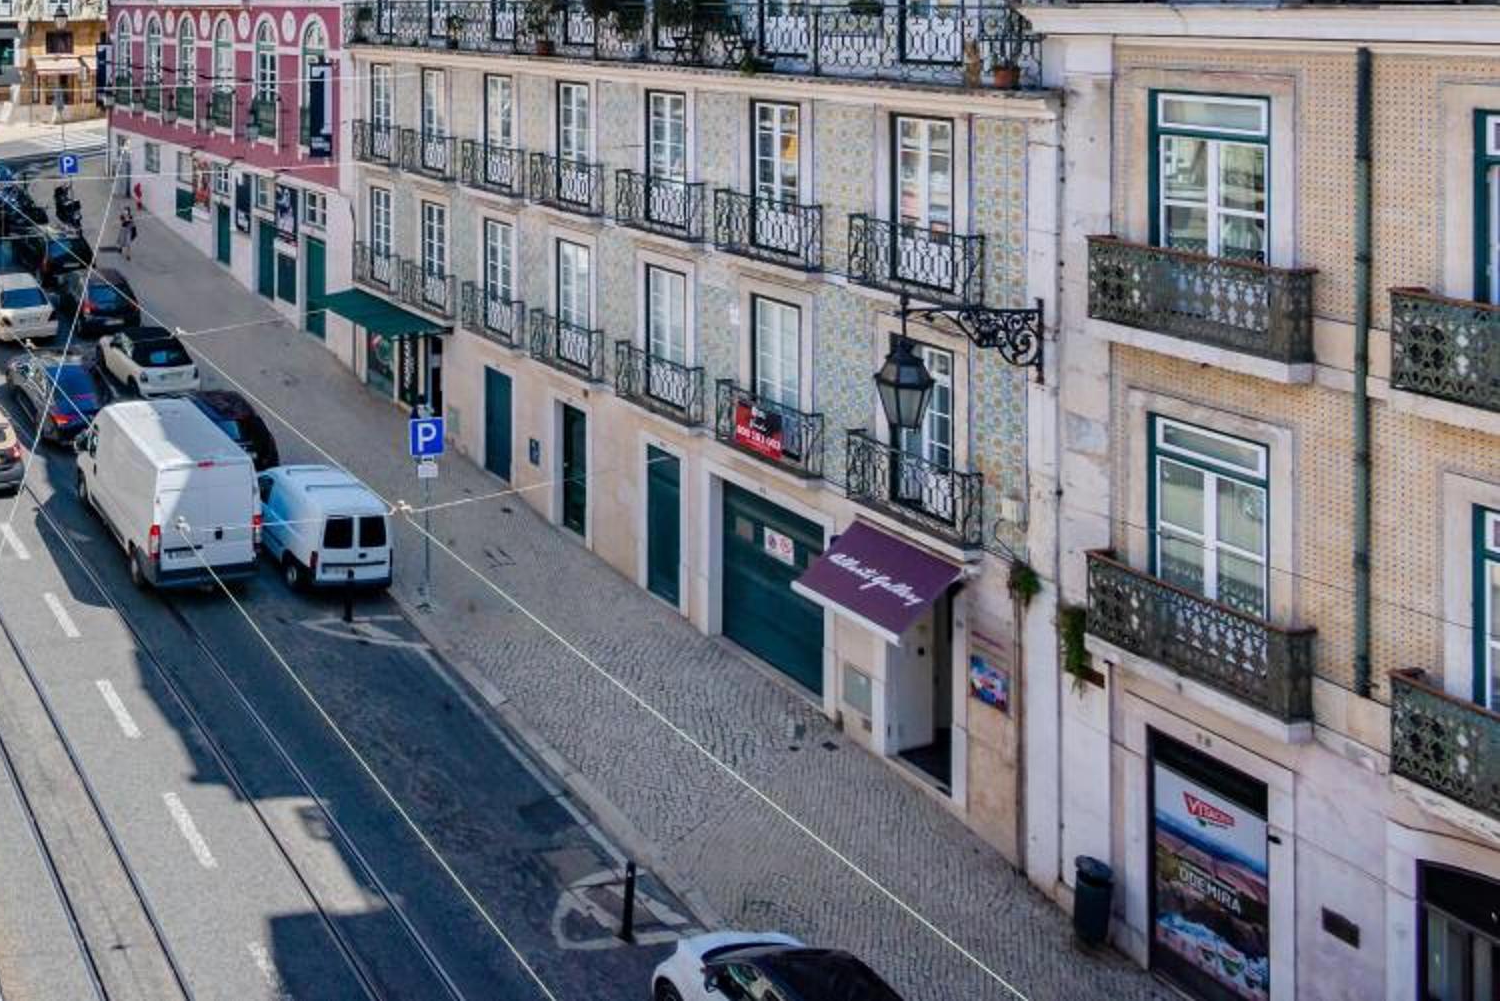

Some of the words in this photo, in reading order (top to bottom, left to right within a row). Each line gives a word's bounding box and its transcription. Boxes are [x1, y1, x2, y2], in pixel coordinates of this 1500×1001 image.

[63, 156, 74, 173] P
[417, 423, 437, 453] P
[1179, 865, 1242, 916] ODEMIRA
